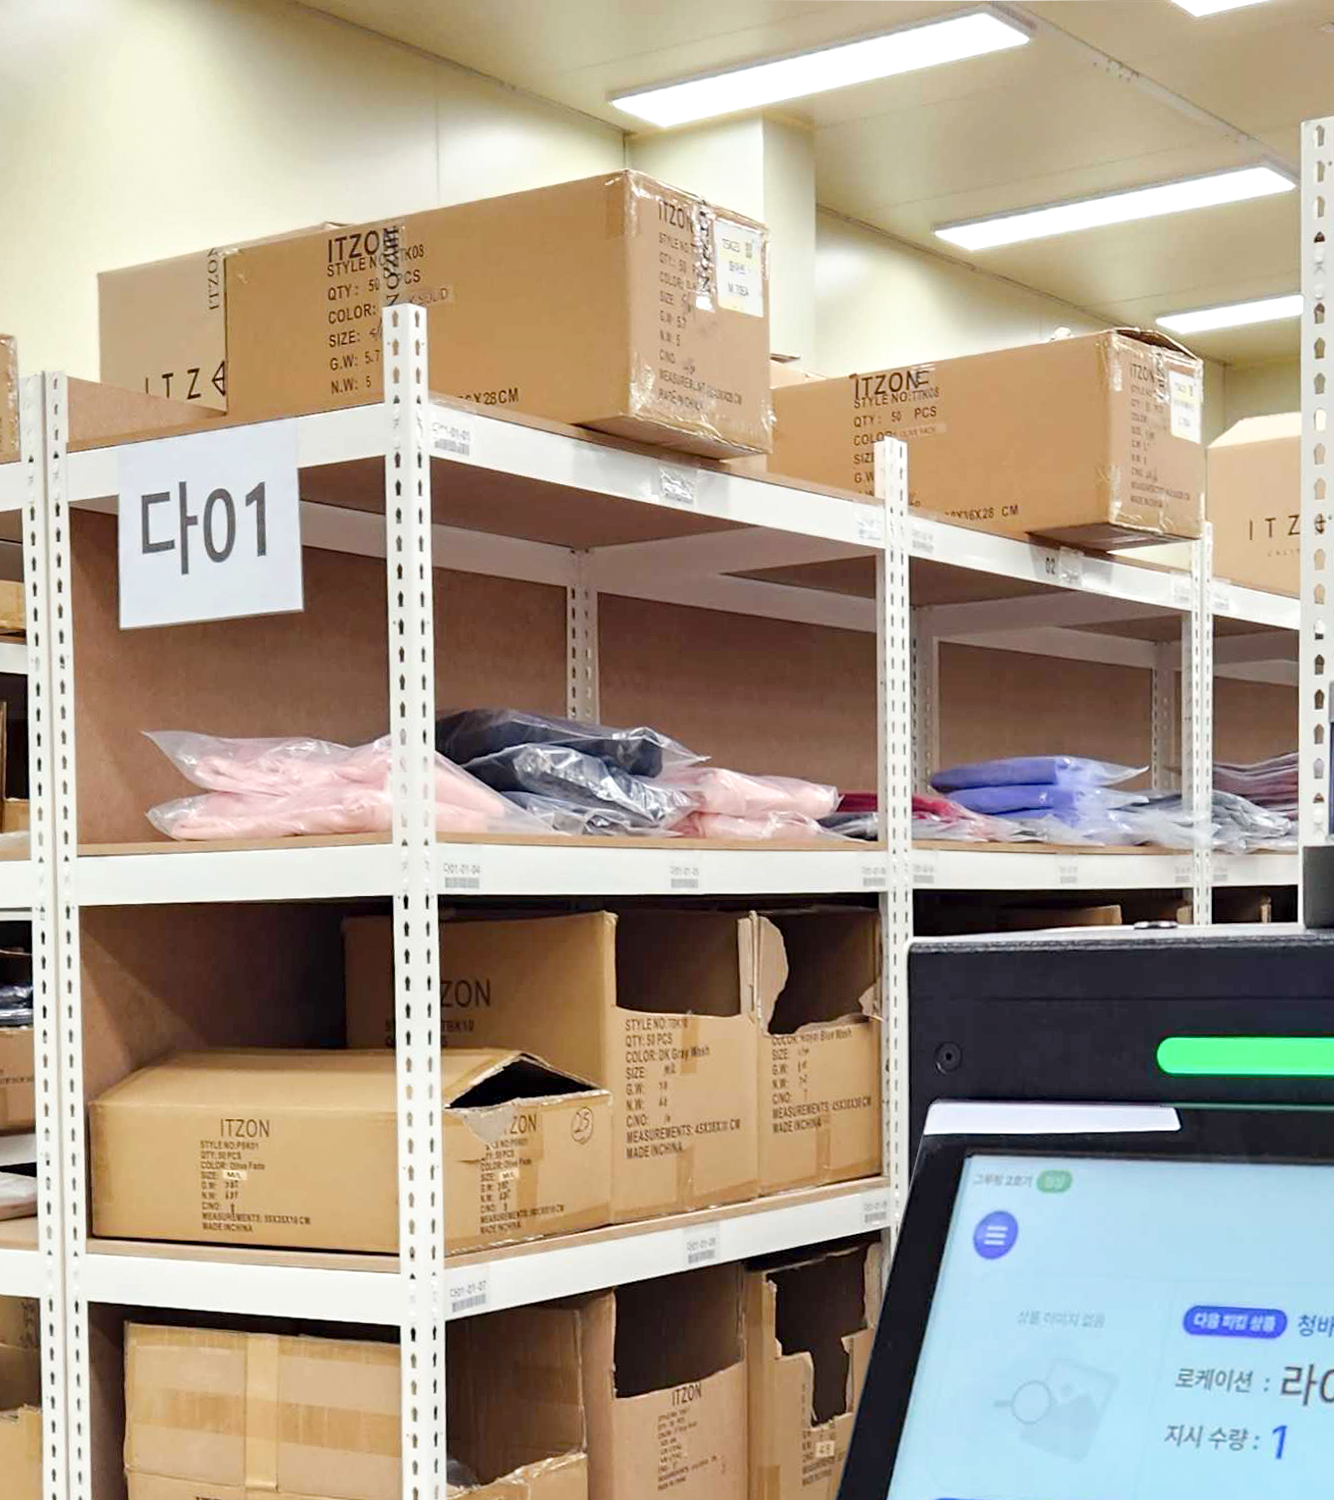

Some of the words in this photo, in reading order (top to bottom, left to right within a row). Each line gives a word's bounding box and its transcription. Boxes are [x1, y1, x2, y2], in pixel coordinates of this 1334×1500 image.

[327, 257, 366, 277] STYLE
[328, 303, 376, 324] COLOR:
[328, 330, 361, 348] SIZE:
[914, 406, 937, 419] PCS
[1002, 505, 1019, 516] CM
[141, 481, 266, 575] 다01
[625, 1018, 652, 1031] STYLE
[657, 1033, 673, 1045] PCS
[220, 1119, 270, 1137] ITZON
[626, 1125, 694, 1143] MEASUREMENTS:
[200, 1140, 222, 1149] STYLE
[626, 1146, 649, 1159] MADE
[227, 1152, 241, 1160] PCS
[1043, 1310, 1080, 1328] 이미지
[1194, 1312, 1220, 1330] 다음
[1175, 1368, 1253, 1393] 로케이션
[1165, 1424, 1203, 1448] 지시
[1208, 1427, 1248, 1452] 수량
[1272, 1425, 1288, 1460] 1
